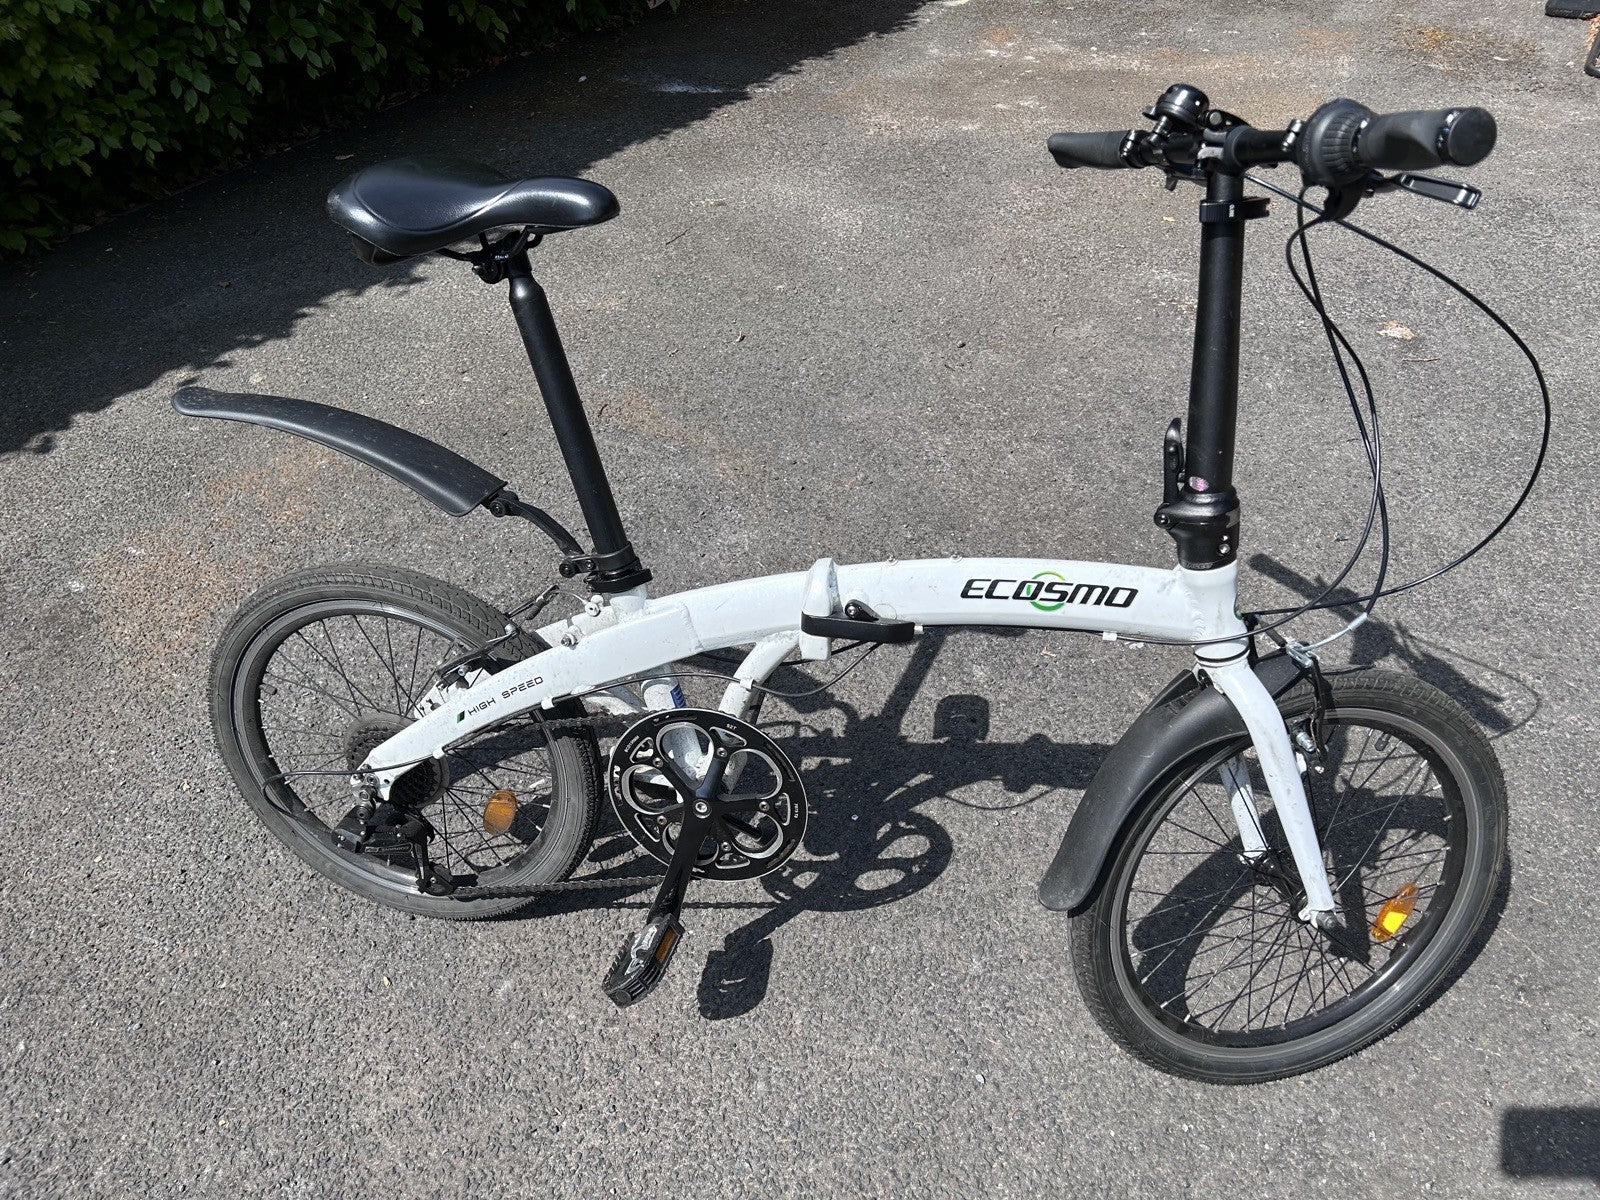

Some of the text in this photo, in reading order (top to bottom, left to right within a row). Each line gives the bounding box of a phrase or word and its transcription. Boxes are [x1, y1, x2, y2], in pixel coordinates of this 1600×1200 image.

[960, 578, 1139, 608] ECOSMO
[467, 676, 544, 716] HIGH SPEED
